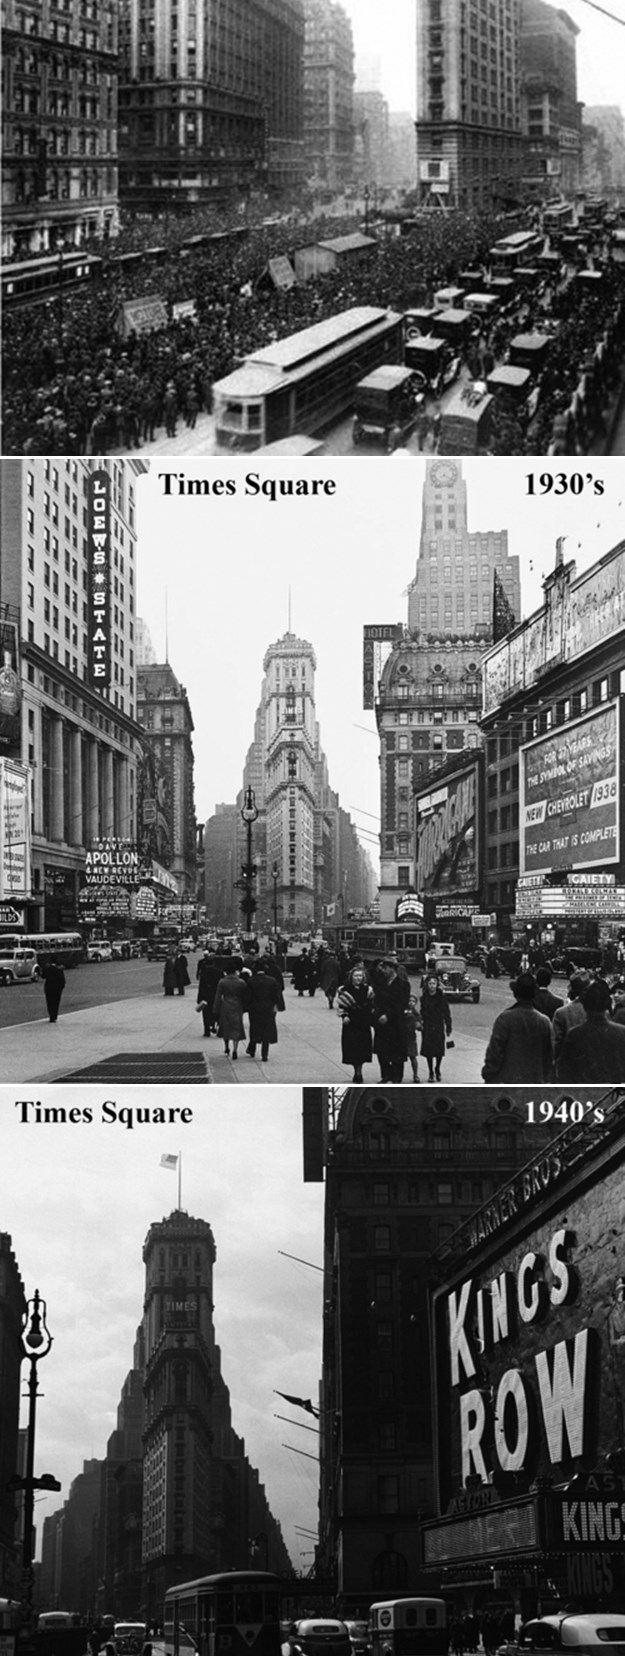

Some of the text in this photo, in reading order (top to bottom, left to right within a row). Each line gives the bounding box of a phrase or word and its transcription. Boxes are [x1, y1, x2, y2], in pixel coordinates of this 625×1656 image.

[93, 592, 107, 678] STATE
[527, 745, 611, 788] THE SYMBOL OF SAVINGS
[525, 782, 617, 823] NEW CHEVROLET 1938
[526, 824, 617, 856] THE CAR THAT IS COMPLETE
[85, 852, 139, 865] APOLLON
[85, 875, 140, 884] VAUDEVILLE
[571, 874, 613, 884] GAIETY
[165, 1301, 198, 1312] TIMES
[448, 1228, 570, 1387] KINGS
[460, 1327, 588, 1490] ROW
